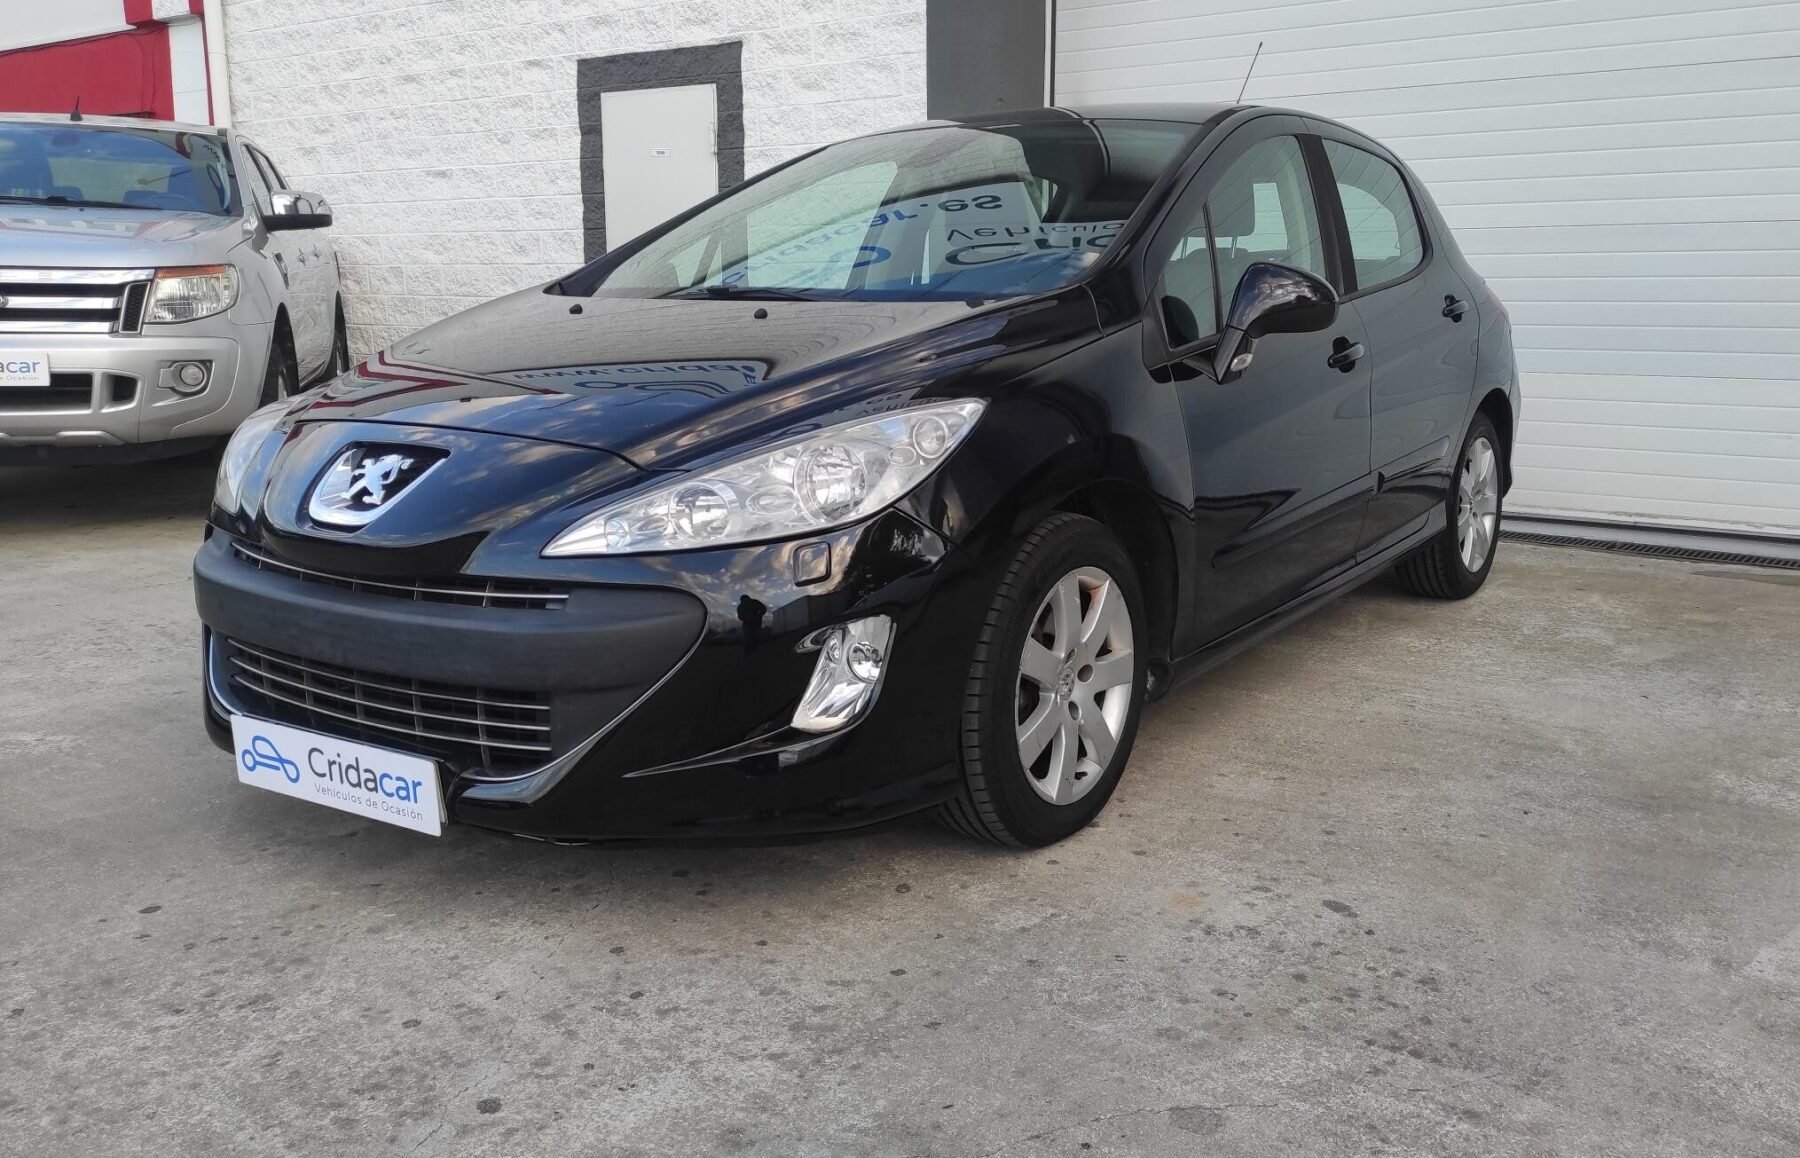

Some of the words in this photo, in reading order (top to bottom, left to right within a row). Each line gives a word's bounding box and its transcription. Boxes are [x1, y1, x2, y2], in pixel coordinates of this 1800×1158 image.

[307, 746, 423, 804] Cridacar
[366, 798, 385, 809] de
[381, 800, 423, 820] Ocasión
